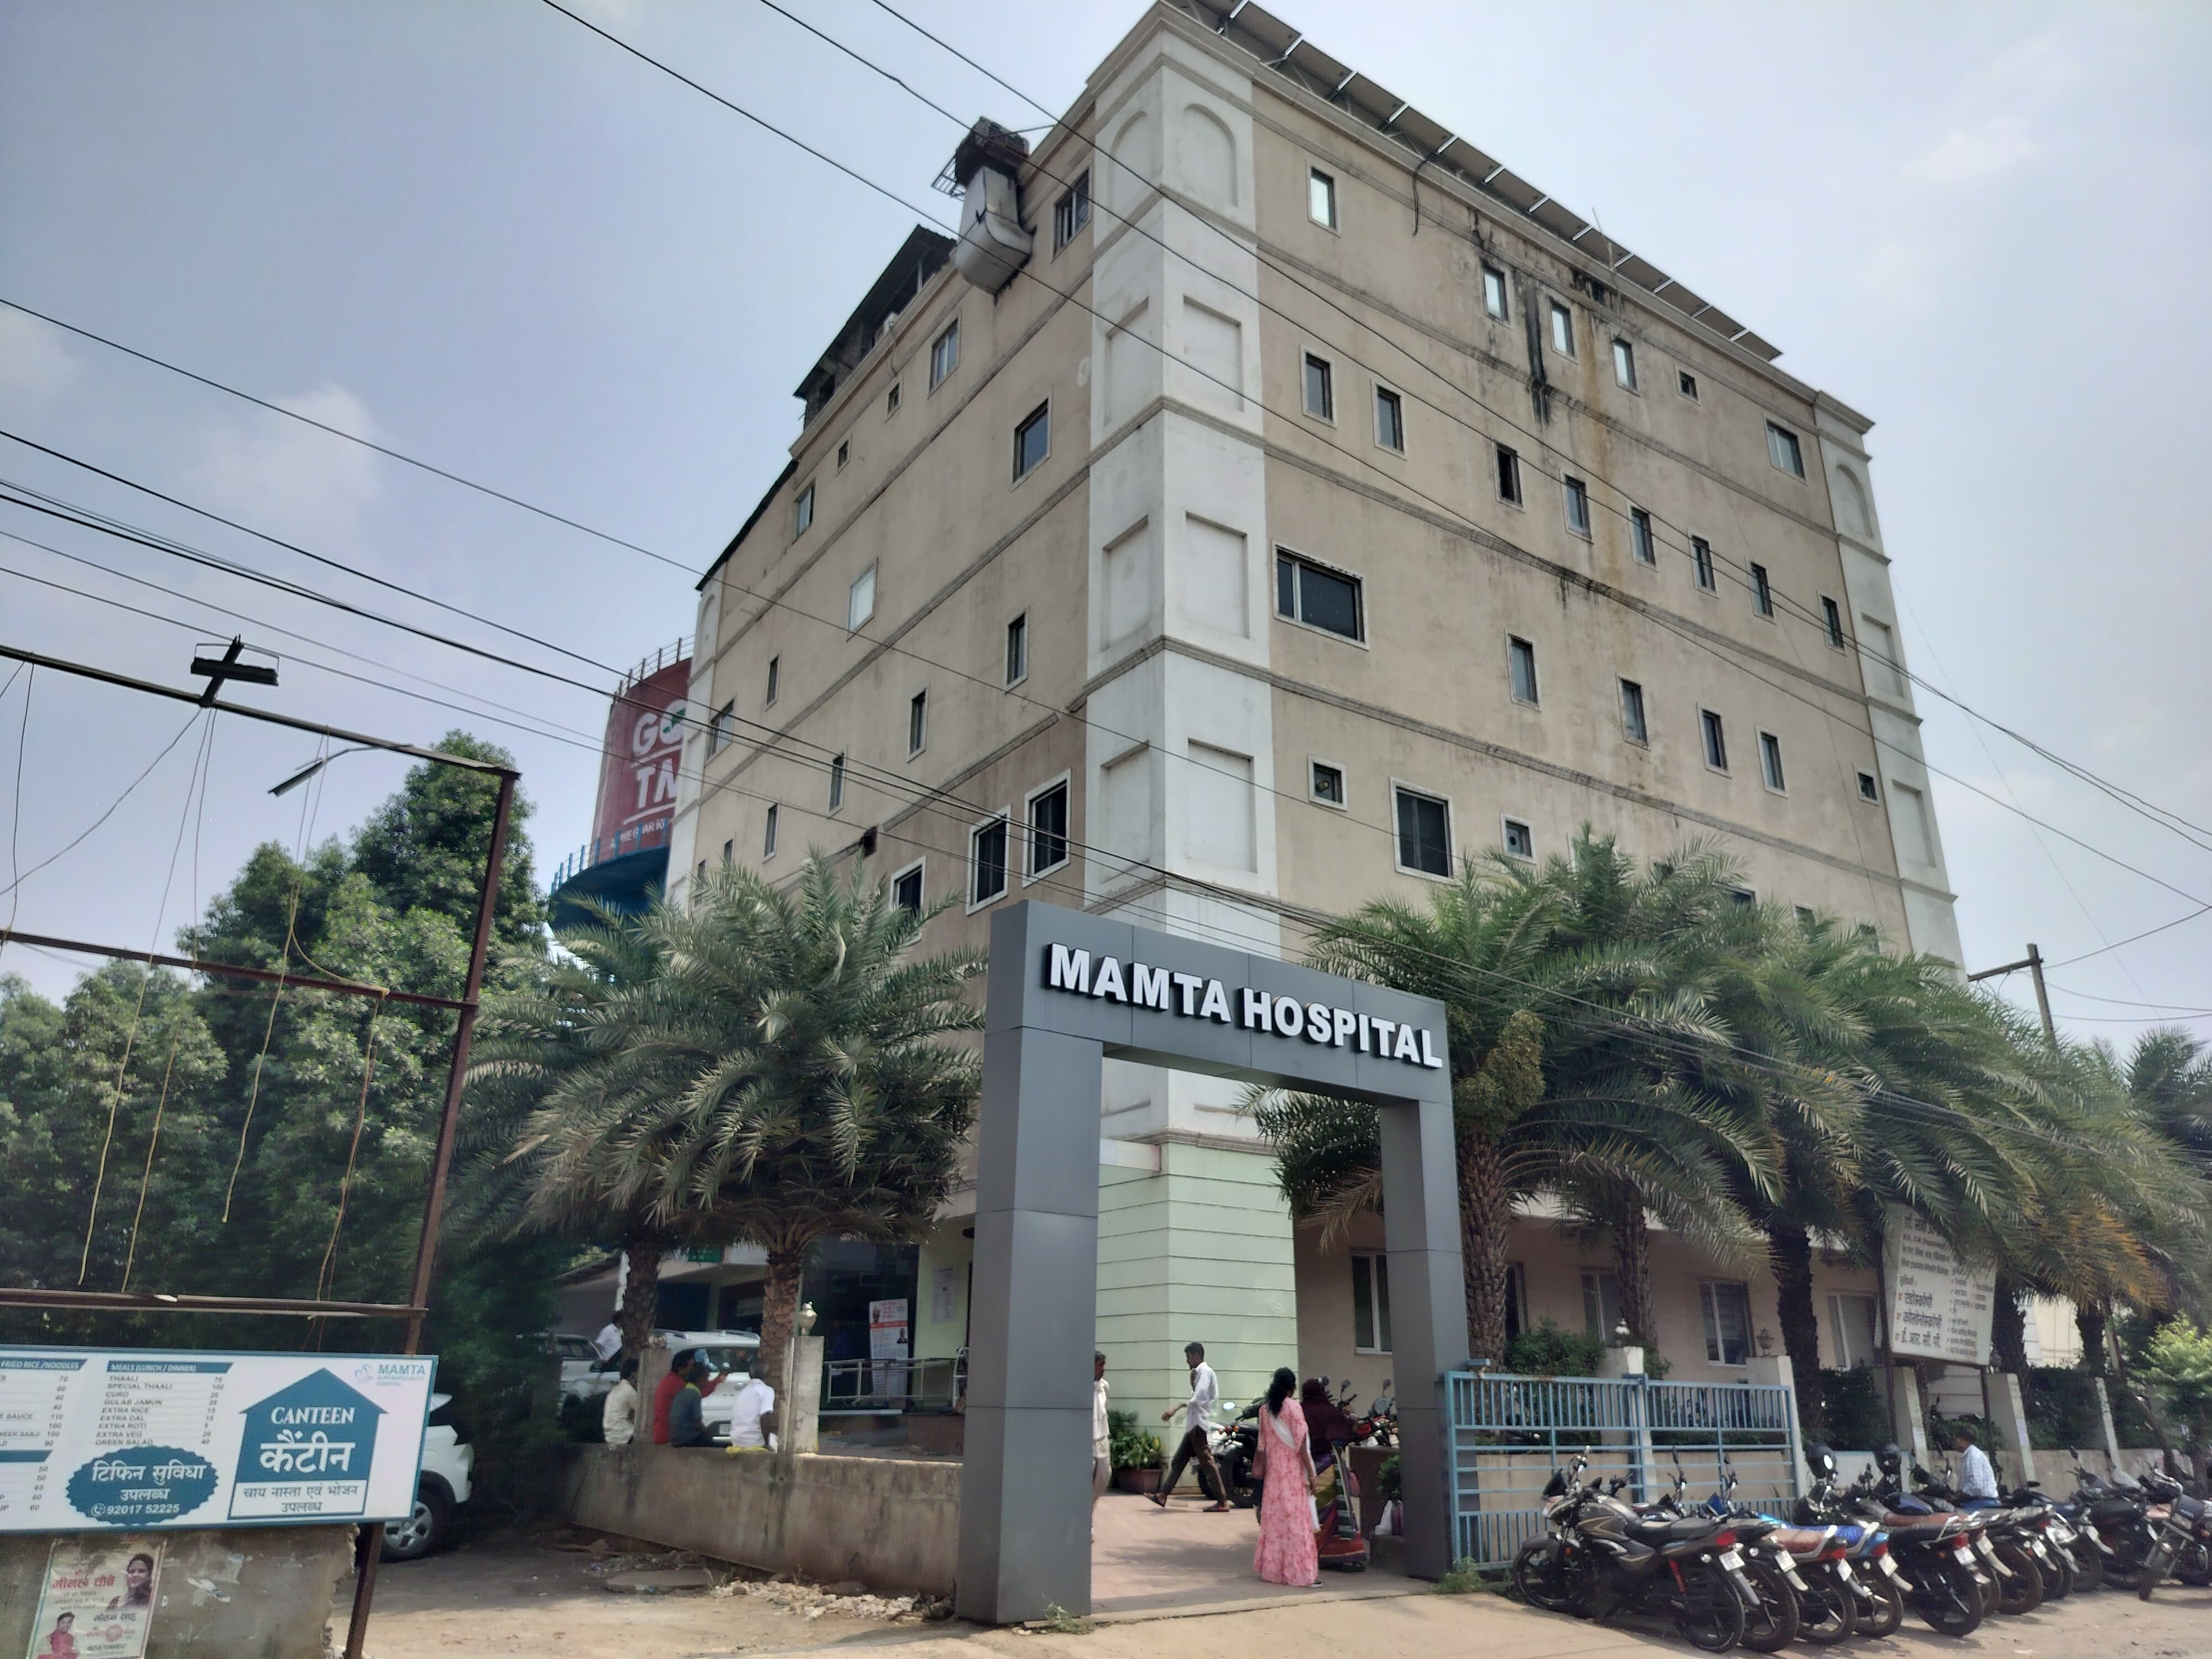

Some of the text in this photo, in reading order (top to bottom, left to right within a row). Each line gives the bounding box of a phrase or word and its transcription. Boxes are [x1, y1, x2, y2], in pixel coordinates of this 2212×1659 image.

[1048, 942, 1443, 1069] MAMTA HOSPITAL
[378, 1364, 425, 1375] MAMTA
[271, 1406, 355, 1425] CANTEEN
[260, 1429, 356, 1474] कैंटीन
[92, 1459, 206, 1486] टिफिन सुविधा
[120, 1488, 171, 1501] उपलब्ध
[243, 1487, 266, 1498] चाय
[306, 1483, 322, 1499] एवं
[326, 1481, 359, 1496] भोजन
[281, 1501, 323, 1513] उपलब्ध
